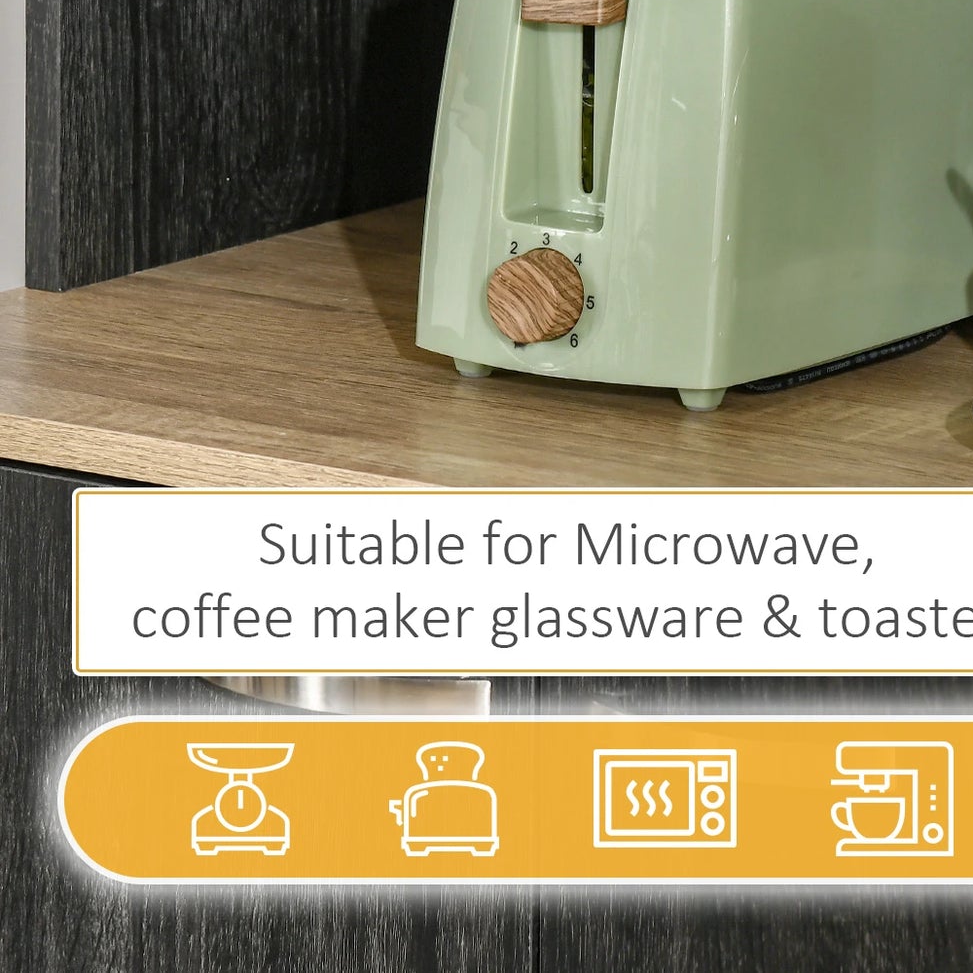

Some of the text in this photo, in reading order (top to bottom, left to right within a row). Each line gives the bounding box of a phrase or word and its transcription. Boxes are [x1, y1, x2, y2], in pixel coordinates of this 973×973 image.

[542, 232, 551, 246] 3
[510, 241, 518, 255] 2
[574, 252, 583, 266] 4
[586, 296, 595, 310] 5
[570, 333, 579, 348] 6
